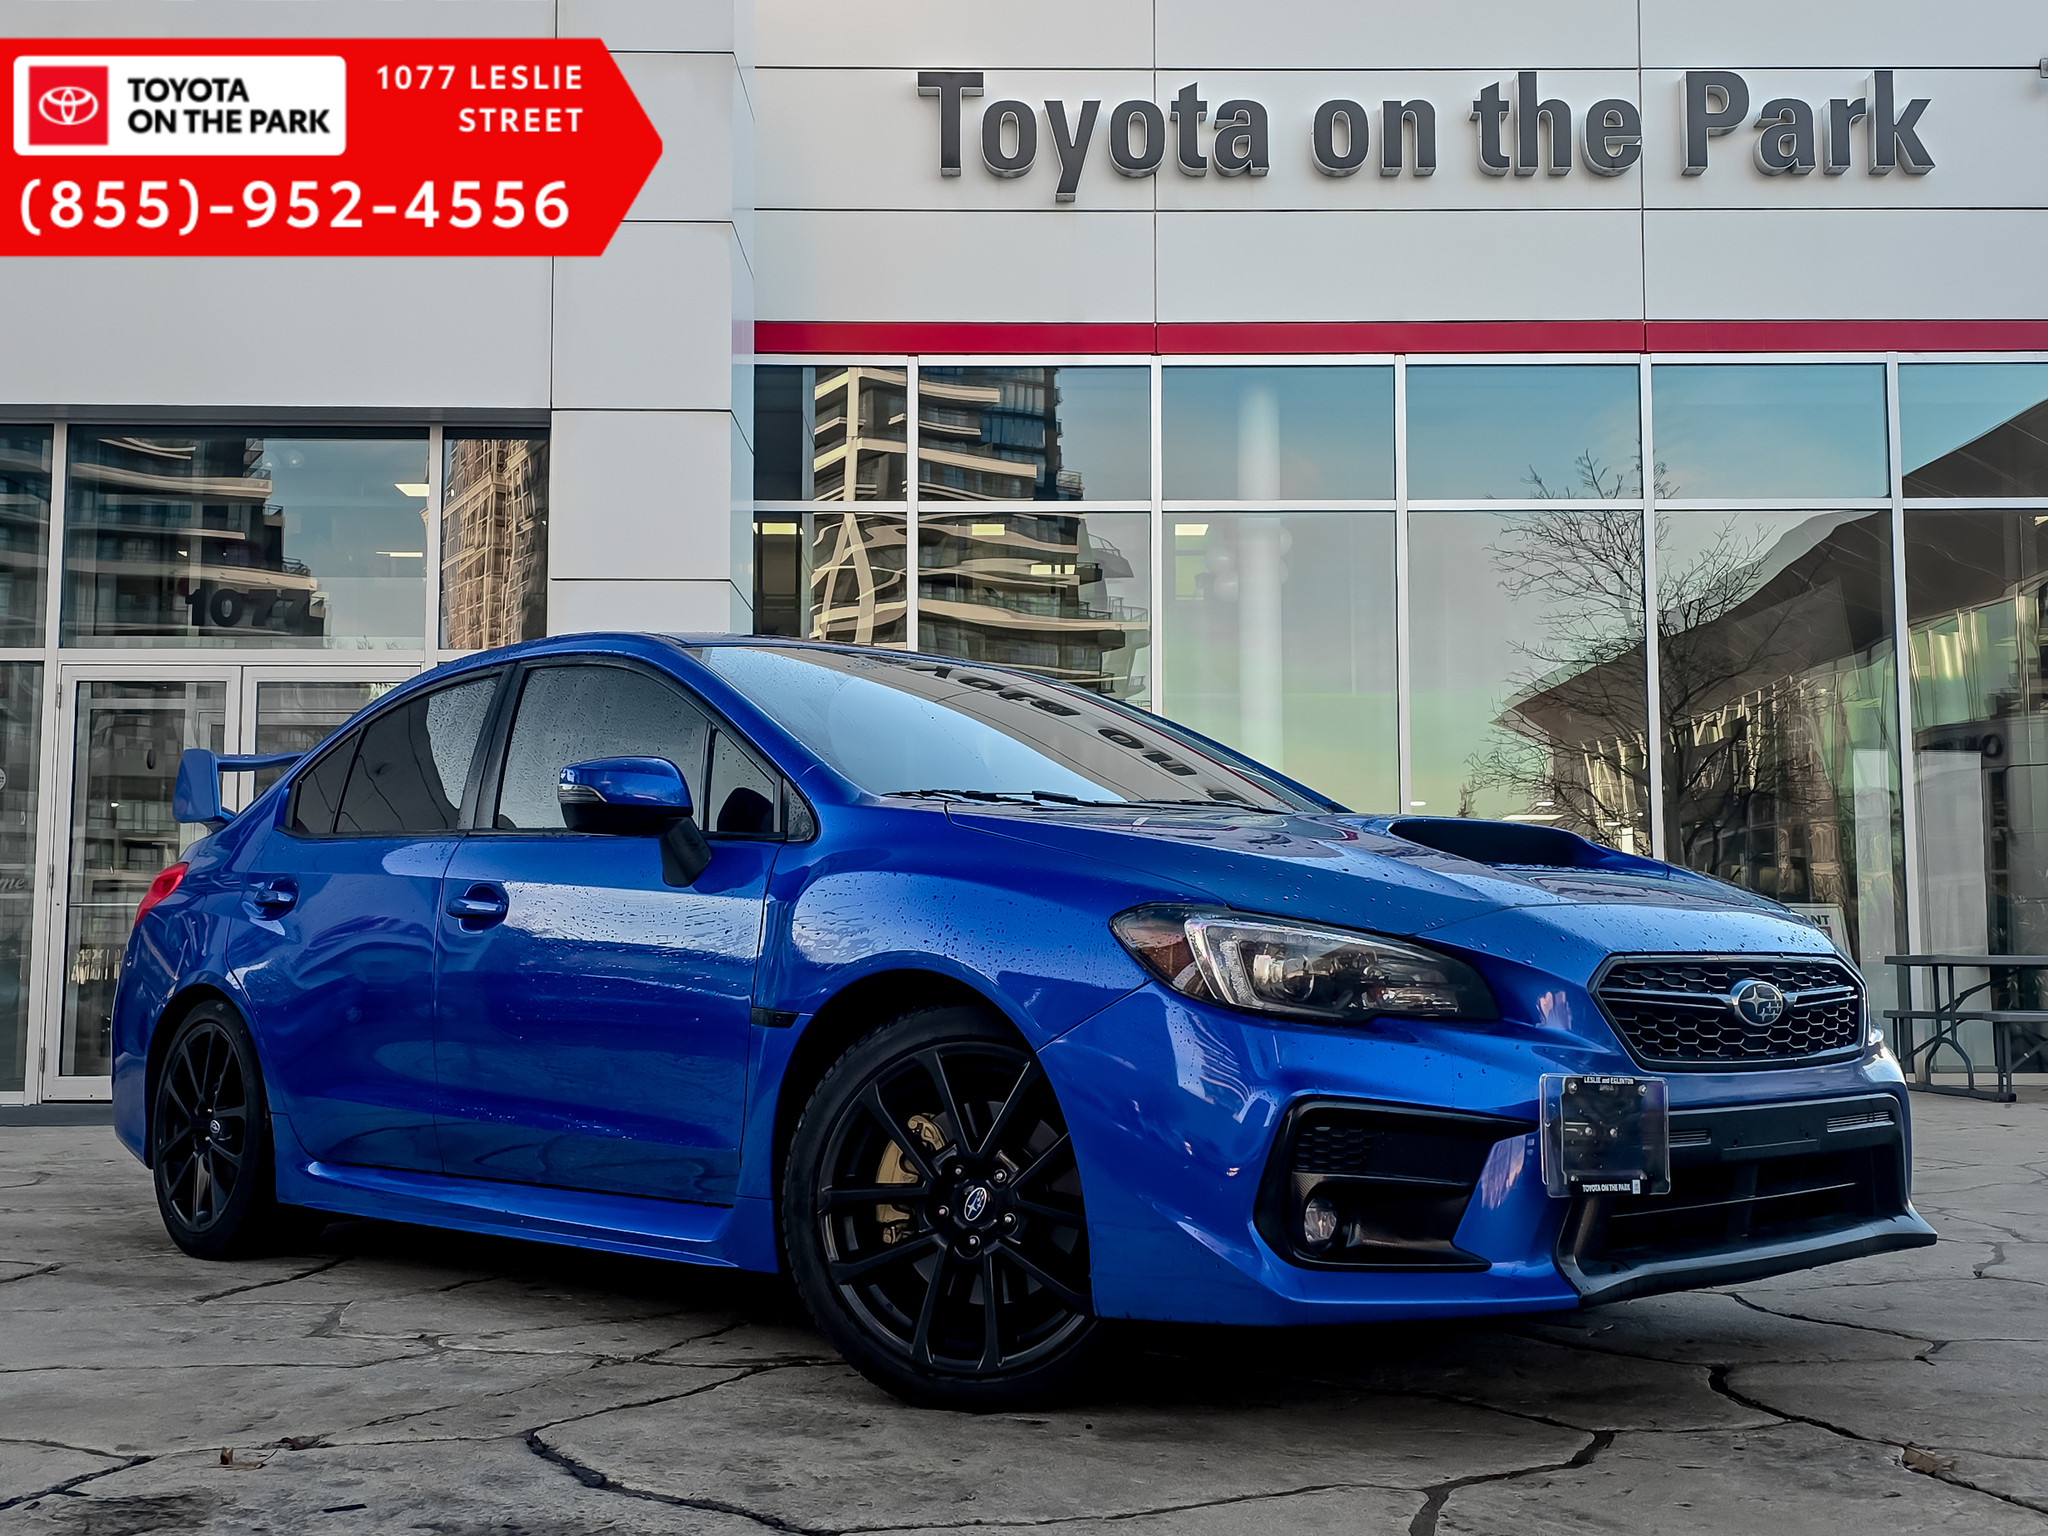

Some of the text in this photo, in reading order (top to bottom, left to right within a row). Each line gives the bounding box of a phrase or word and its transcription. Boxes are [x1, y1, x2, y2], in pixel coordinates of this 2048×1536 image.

[916, 70, 1937, 202] Toyota on the Park
[185, 588, 311, 628] 1077
[1582, 1184, 1601, 1192] TOYOTA
[1618, 1183, 1631, 1191] PARK
